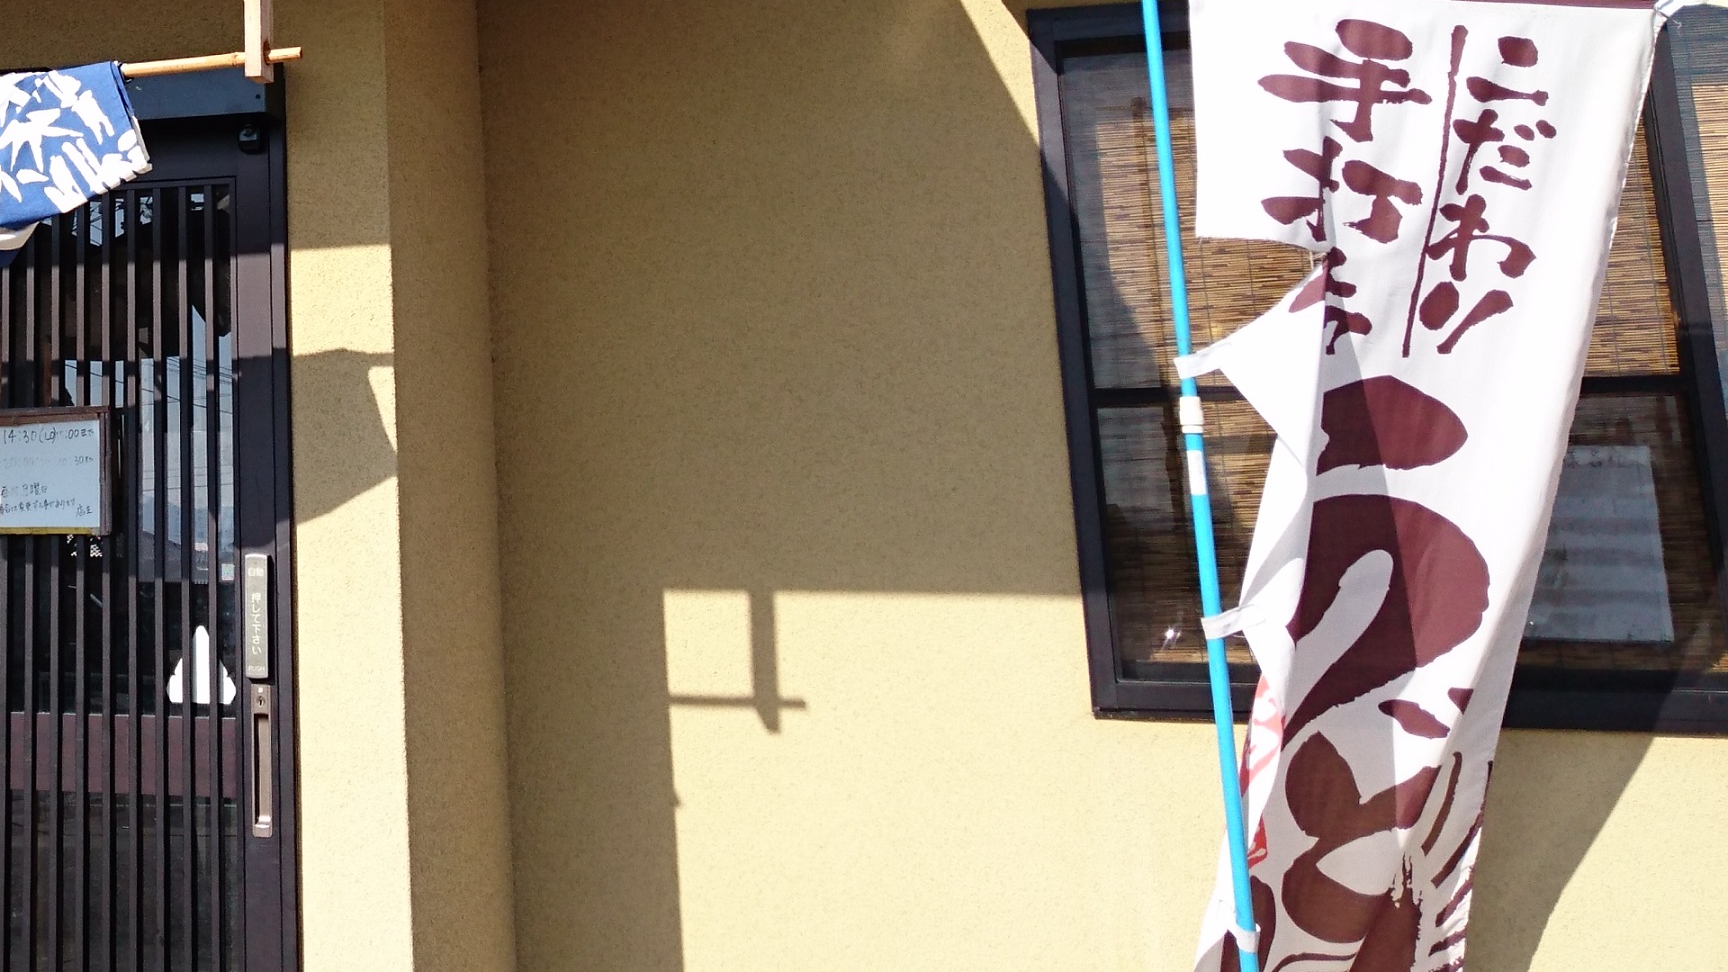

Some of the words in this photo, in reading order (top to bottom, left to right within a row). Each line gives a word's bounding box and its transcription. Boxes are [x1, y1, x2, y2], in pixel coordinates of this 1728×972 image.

[1420, 35, 1557, 354] こだわり
[252, 592, 262, 655] 押して下さい
